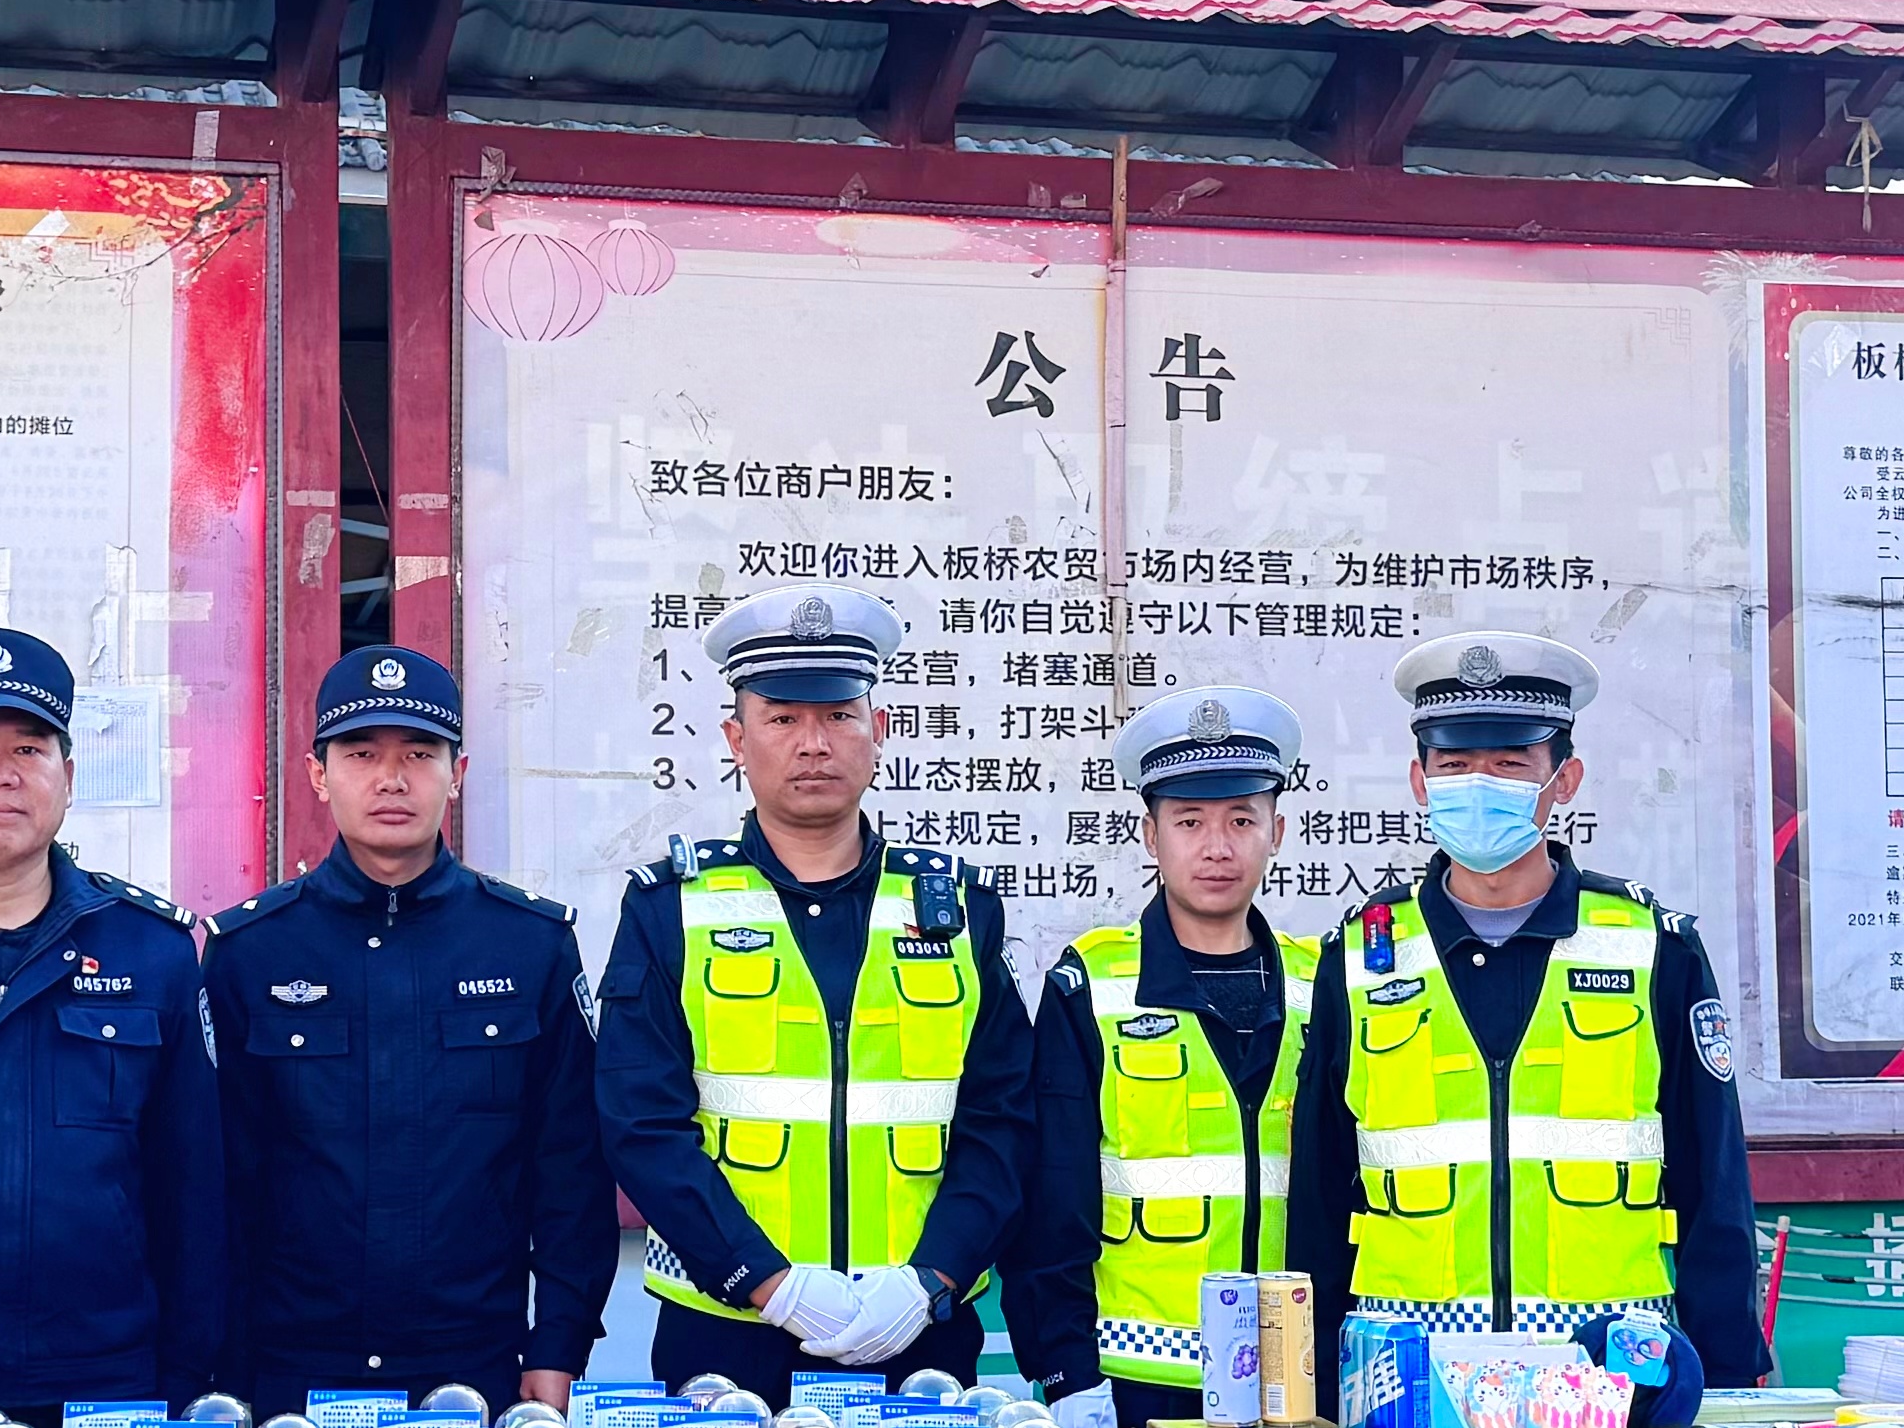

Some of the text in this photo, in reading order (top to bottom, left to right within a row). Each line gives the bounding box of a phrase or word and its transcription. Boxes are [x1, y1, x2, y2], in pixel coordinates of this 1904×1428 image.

[975, 329, 1235, 422] 公告
[650, 460, 953, 502] 致各位商户朋友：
[651, 593, 1421, 639] 提高，请你自觉遵守以下管理规定：
[652, 648, 1177, 689] 1、经营，堵塞通道。
[897, 940, 950, 957] 093047
[73, 976, 132, 993] 045762
[458, 978, 515, 996] 045521
[1574, 973, 1630, 990] XJ0029
